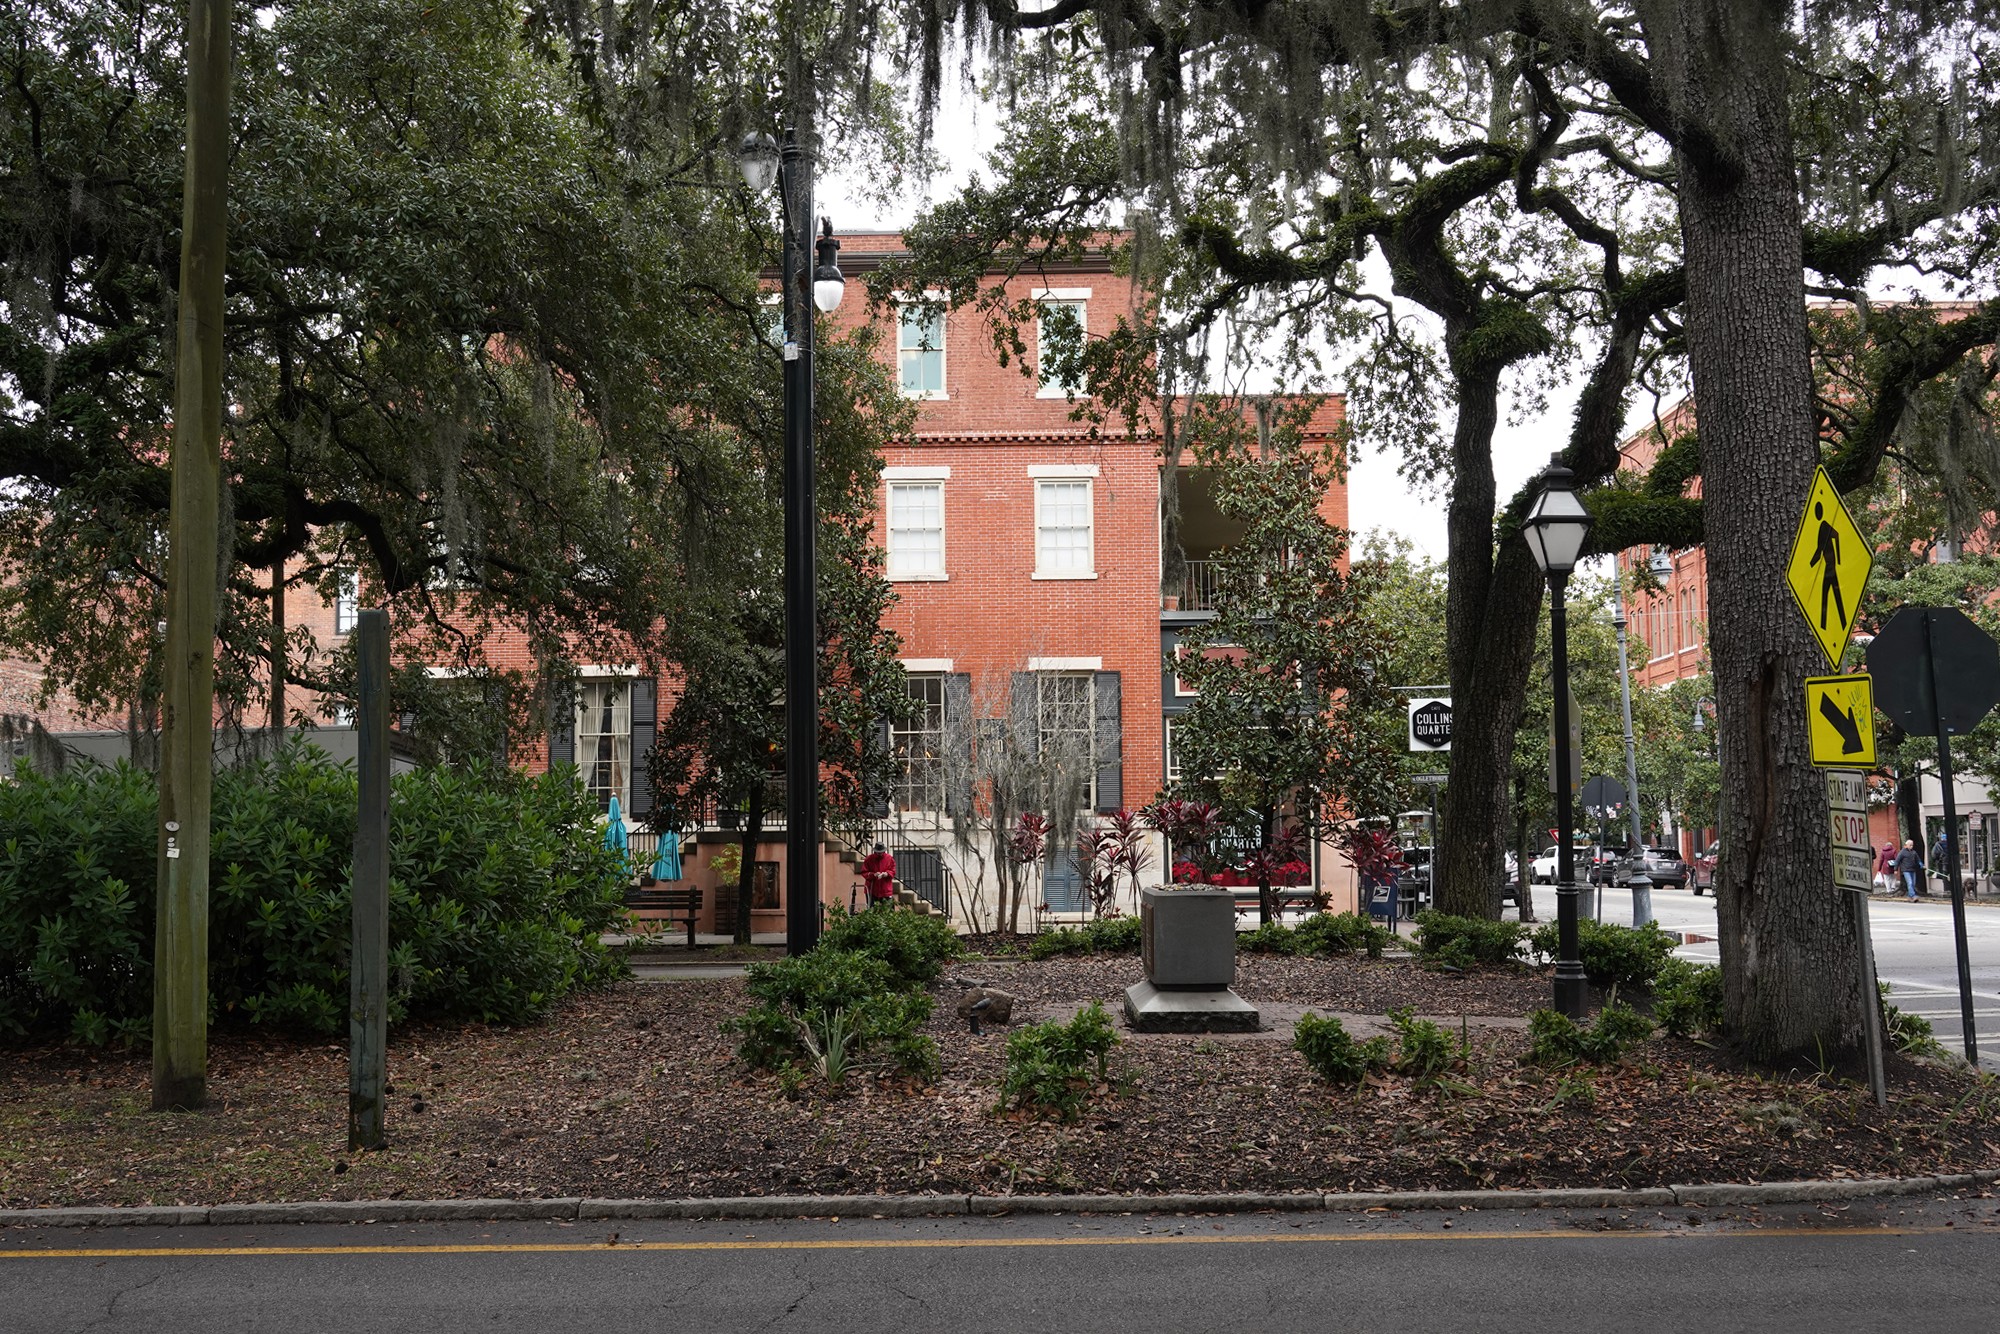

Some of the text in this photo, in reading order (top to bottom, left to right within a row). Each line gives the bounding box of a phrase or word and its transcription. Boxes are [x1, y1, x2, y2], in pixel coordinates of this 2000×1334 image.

[1417, 725, 1450, 735] QUARTE
[1828, 780, 1864, 803] STATE LAW
[1834, 815, 1864, 844] STOP
[1834, 853, 1844, 866] FOR
